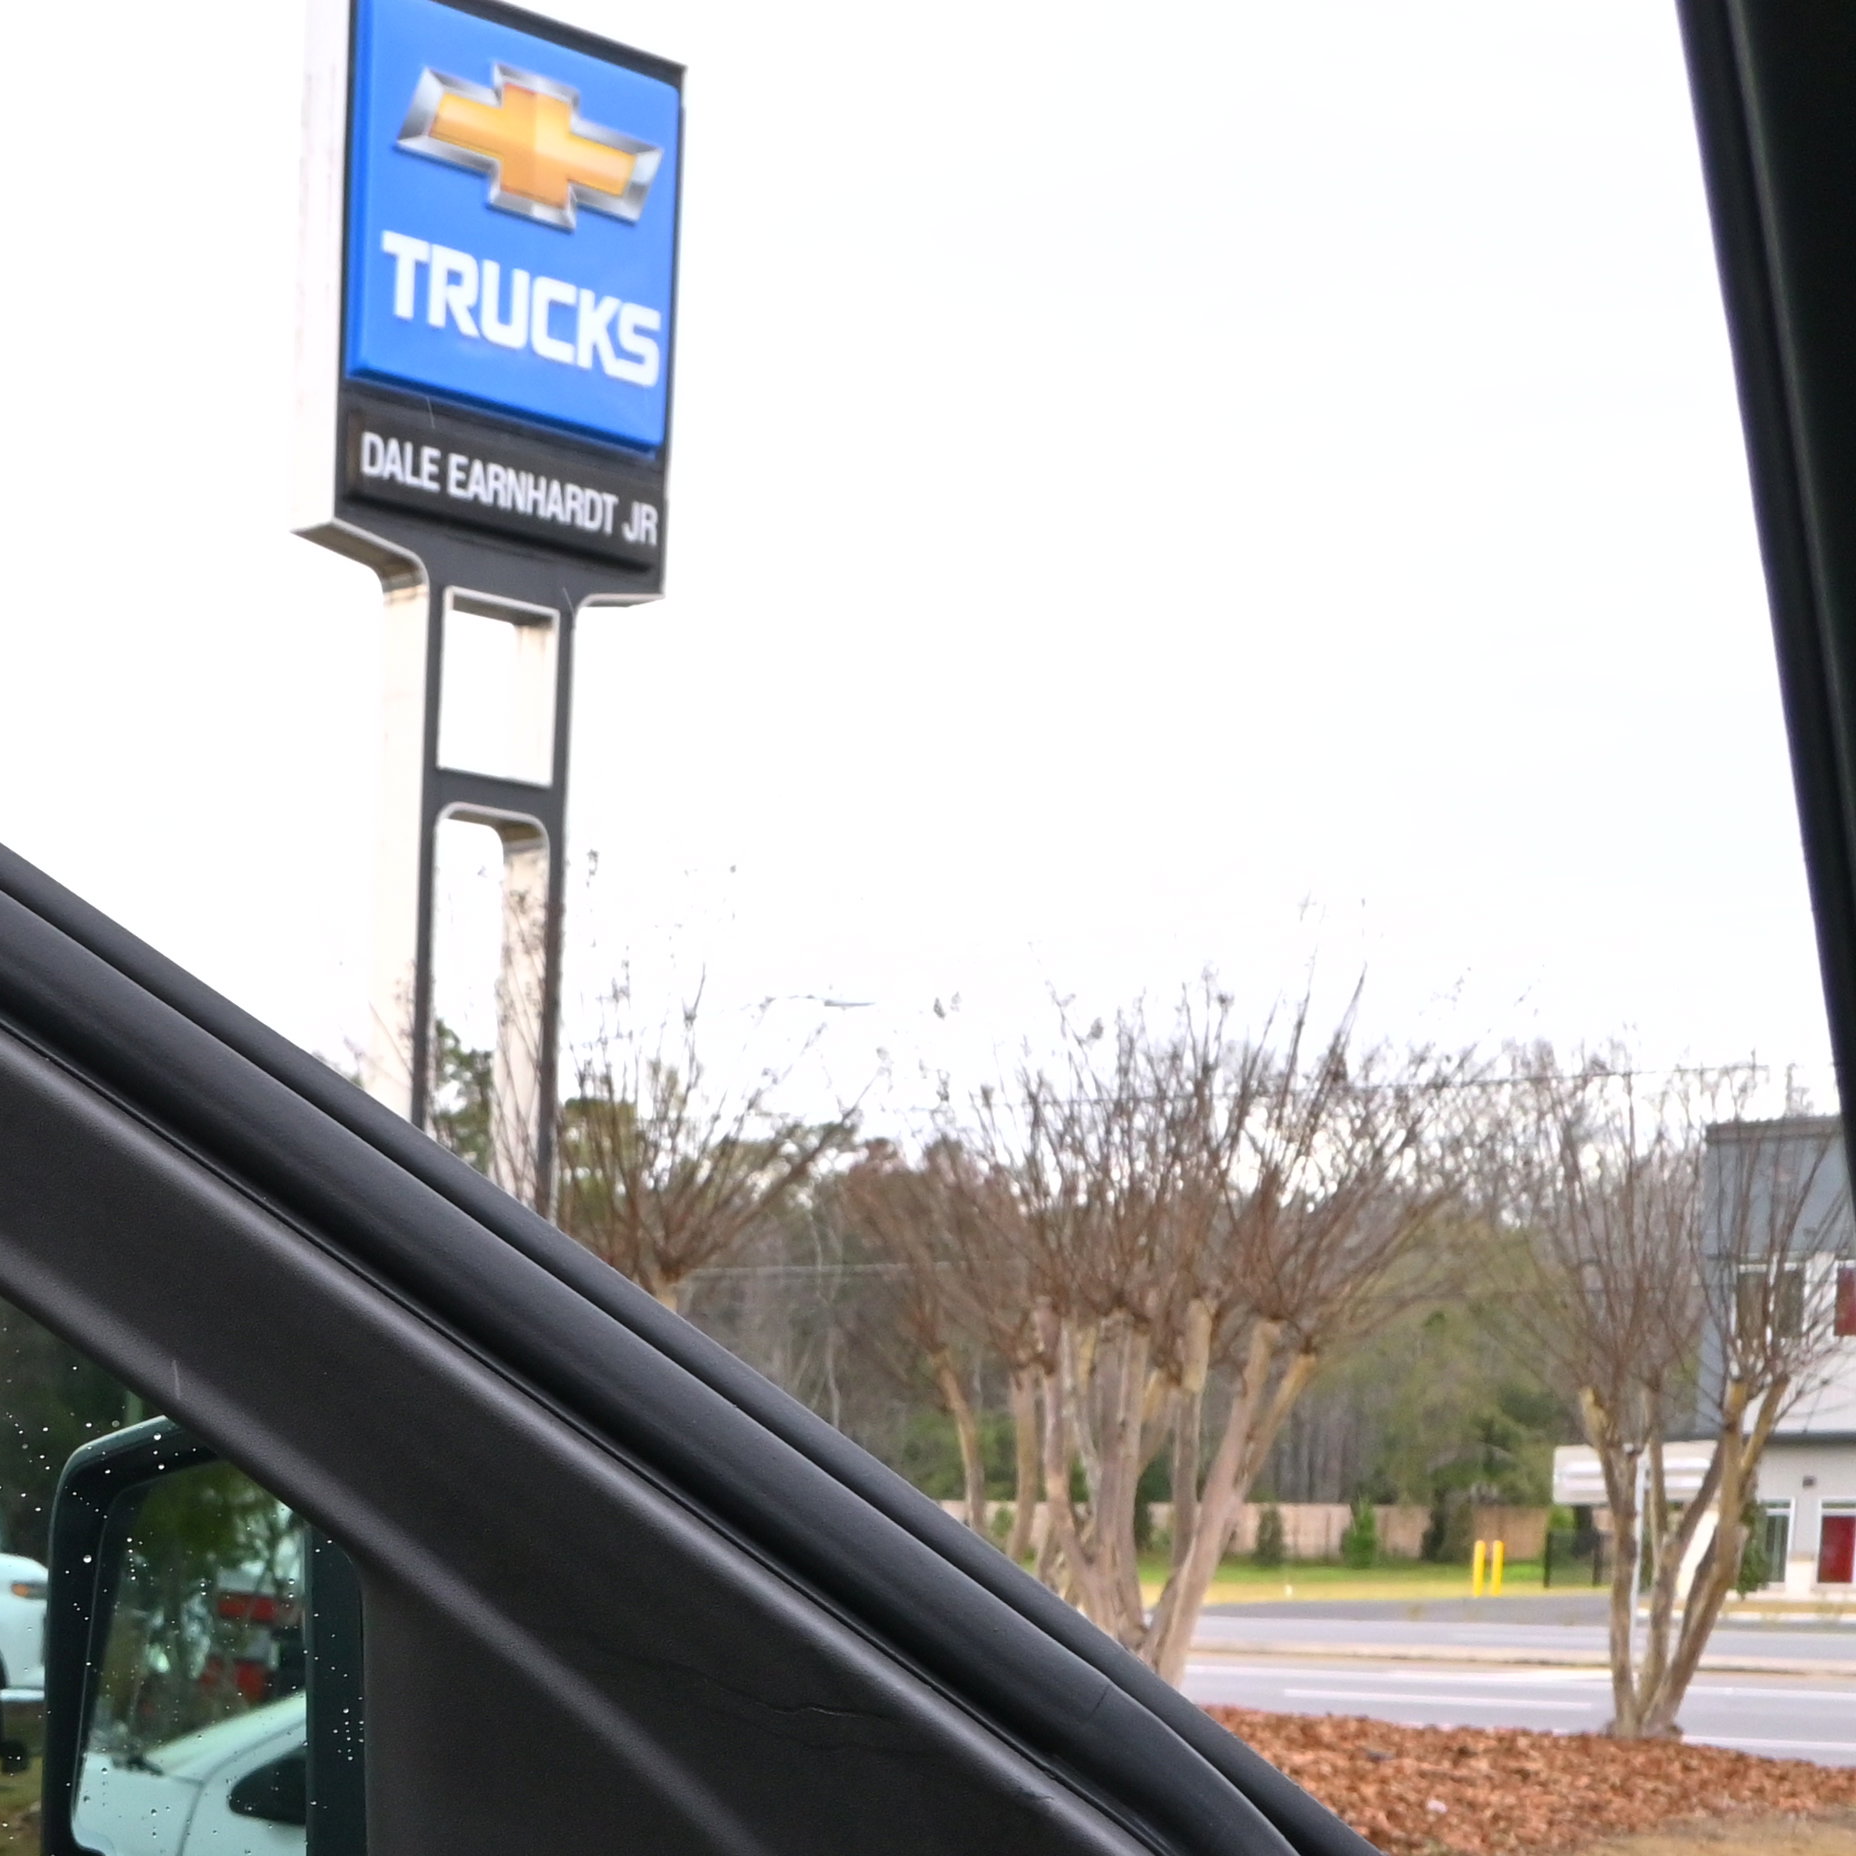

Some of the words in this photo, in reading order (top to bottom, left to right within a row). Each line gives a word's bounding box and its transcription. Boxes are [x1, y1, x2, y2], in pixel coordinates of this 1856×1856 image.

[381, 229, 662, 388] TRUCKS
[361, 431, 441, 492] DALE
[446, 455, 618, 534] EARNHARDT
[623, 500, 658, 548] JR
